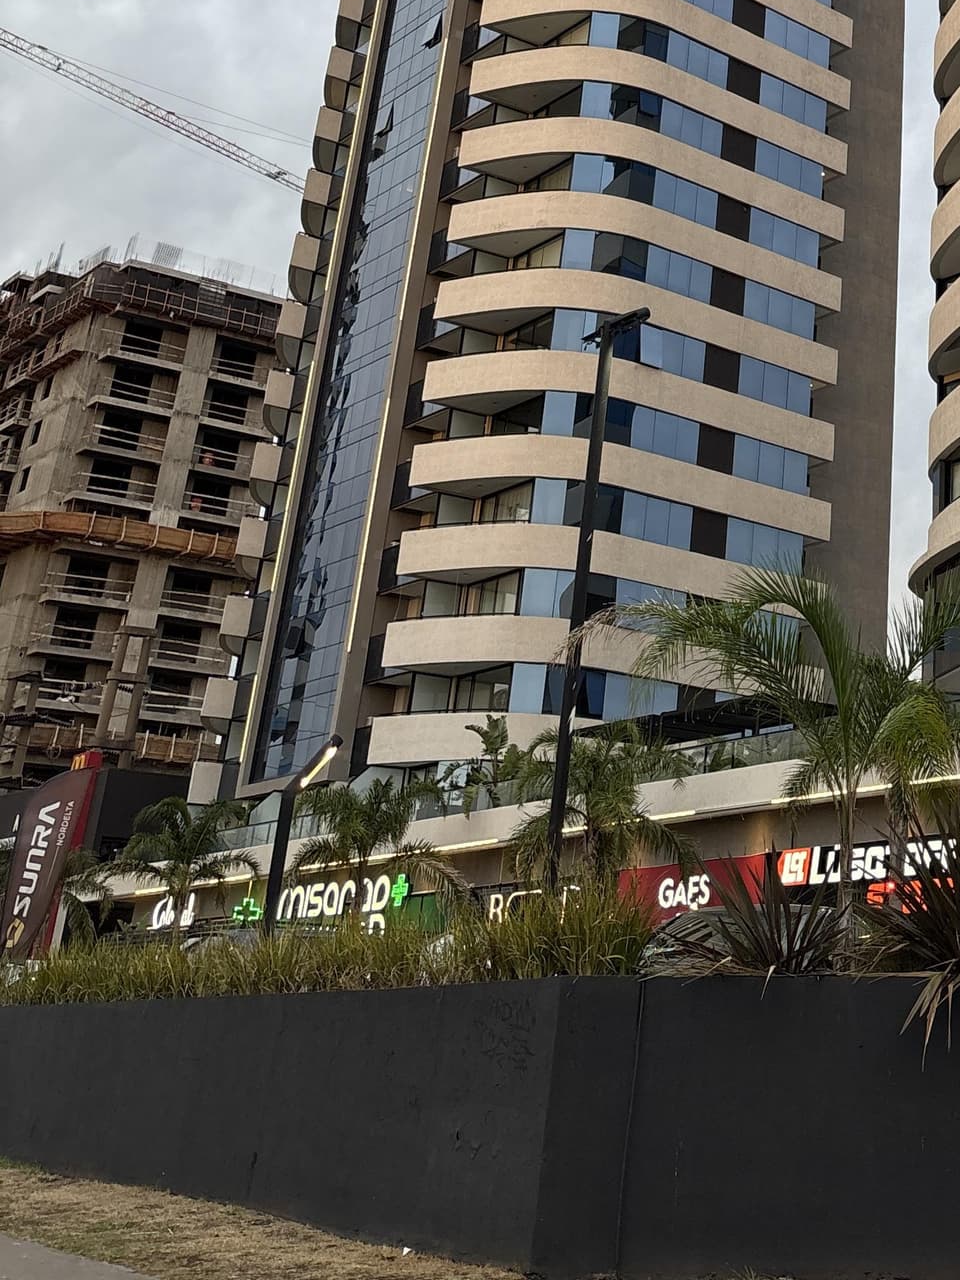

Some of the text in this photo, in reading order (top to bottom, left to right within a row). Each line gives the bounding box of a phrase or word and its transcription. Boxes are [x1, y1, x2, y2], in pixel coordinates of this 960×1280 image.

[56, 800, 74, 846] NORDELTA
[13, 801, 60, 918] SUNRA
[658, 874, 710, 910] GAES
